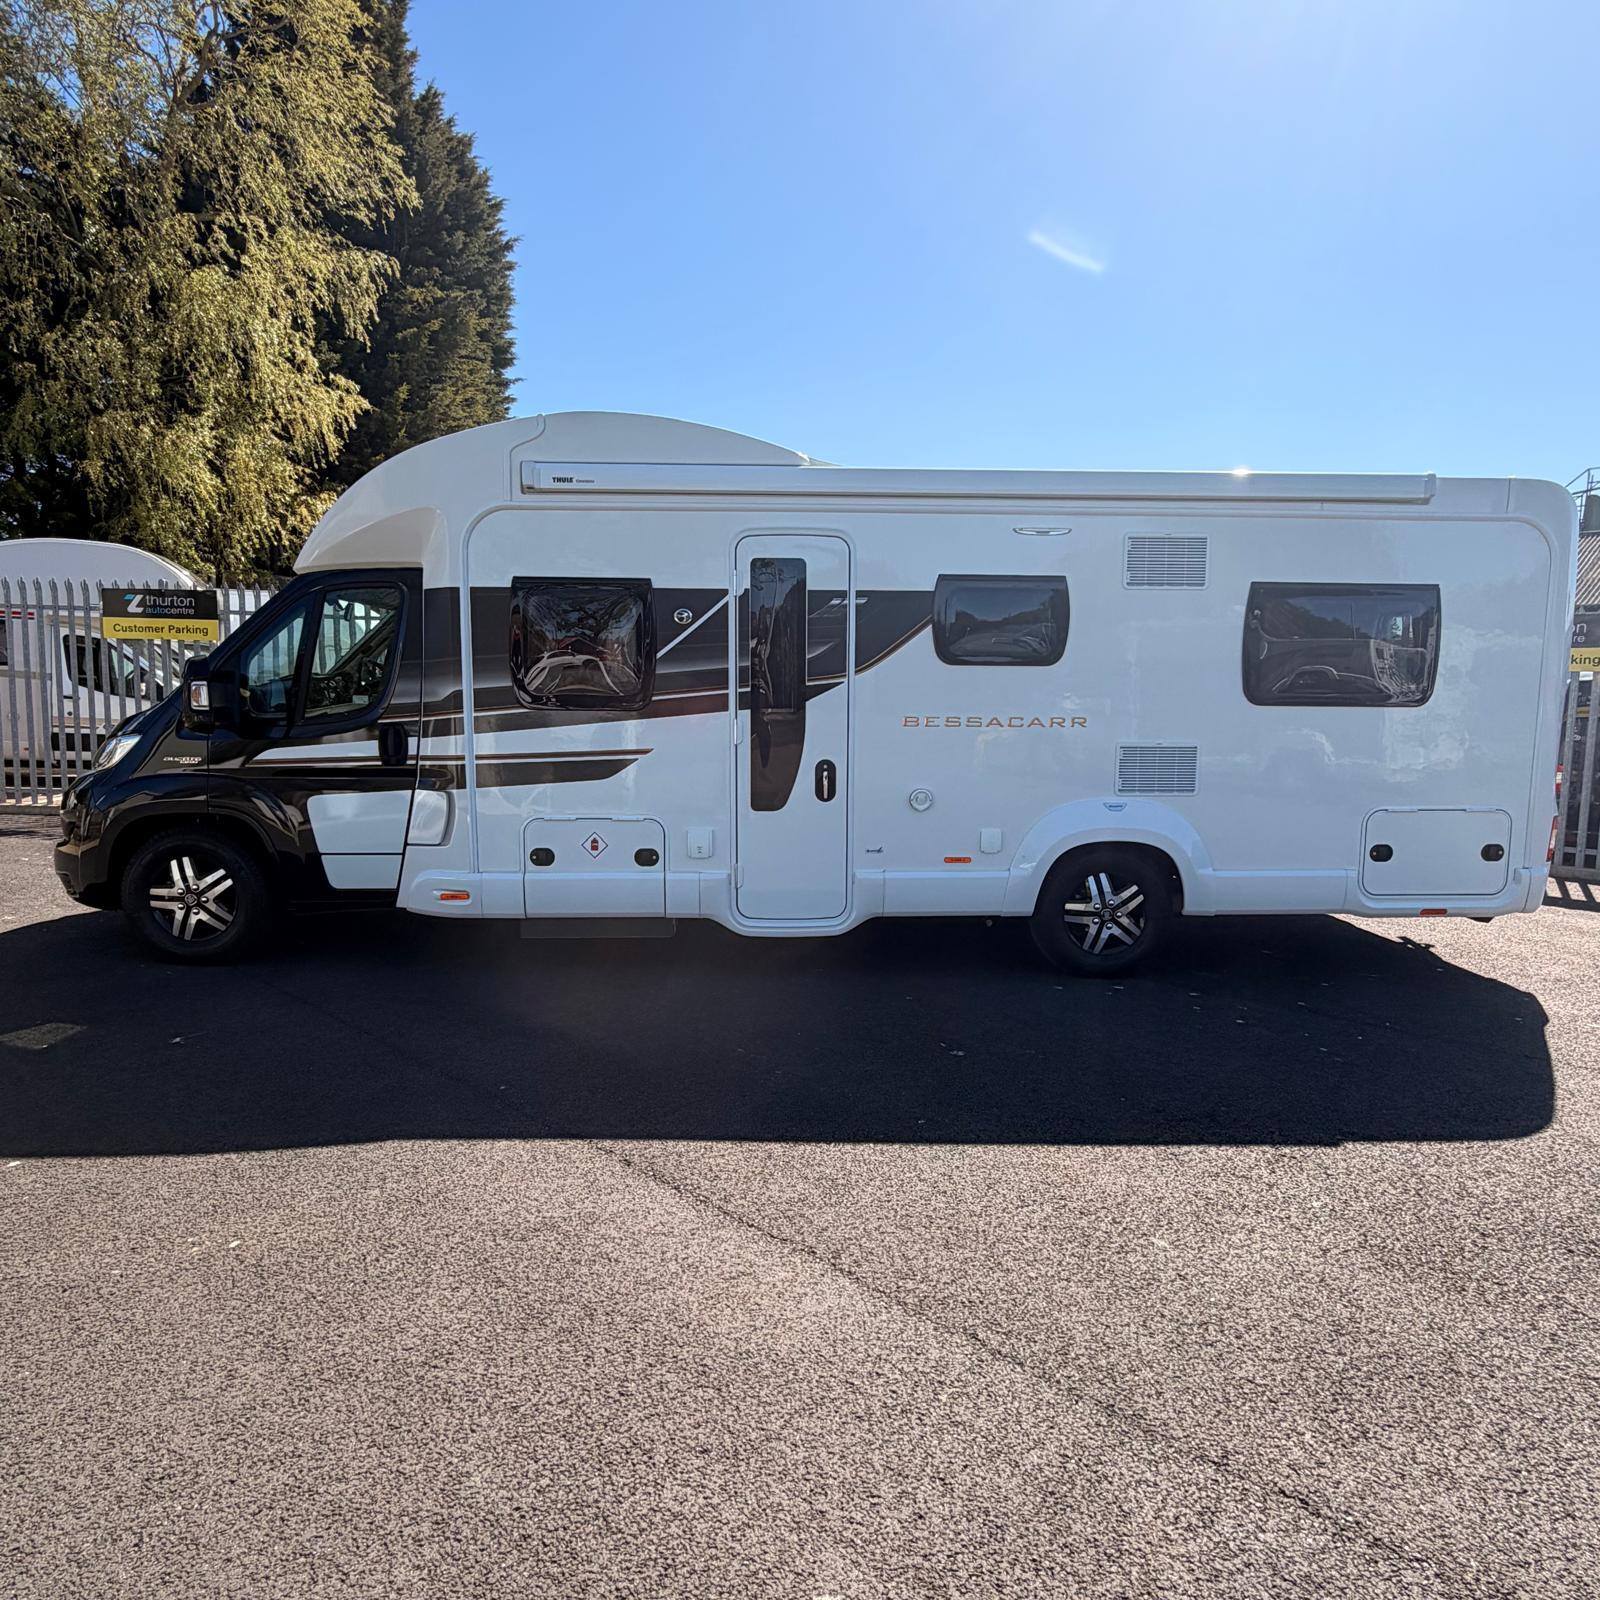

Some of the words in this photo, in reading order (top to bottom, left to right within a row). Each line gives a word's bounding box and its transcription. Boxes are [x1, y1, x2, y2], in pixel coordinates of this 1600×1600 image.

[145, 595, 195, 606] thurton
[145, 607, 194, 615] autocentre
[113, 623, 165, 633] Customer
[168, 625, 208, 636] Parking
[902, 716, 1088, 728] BESSACARR
